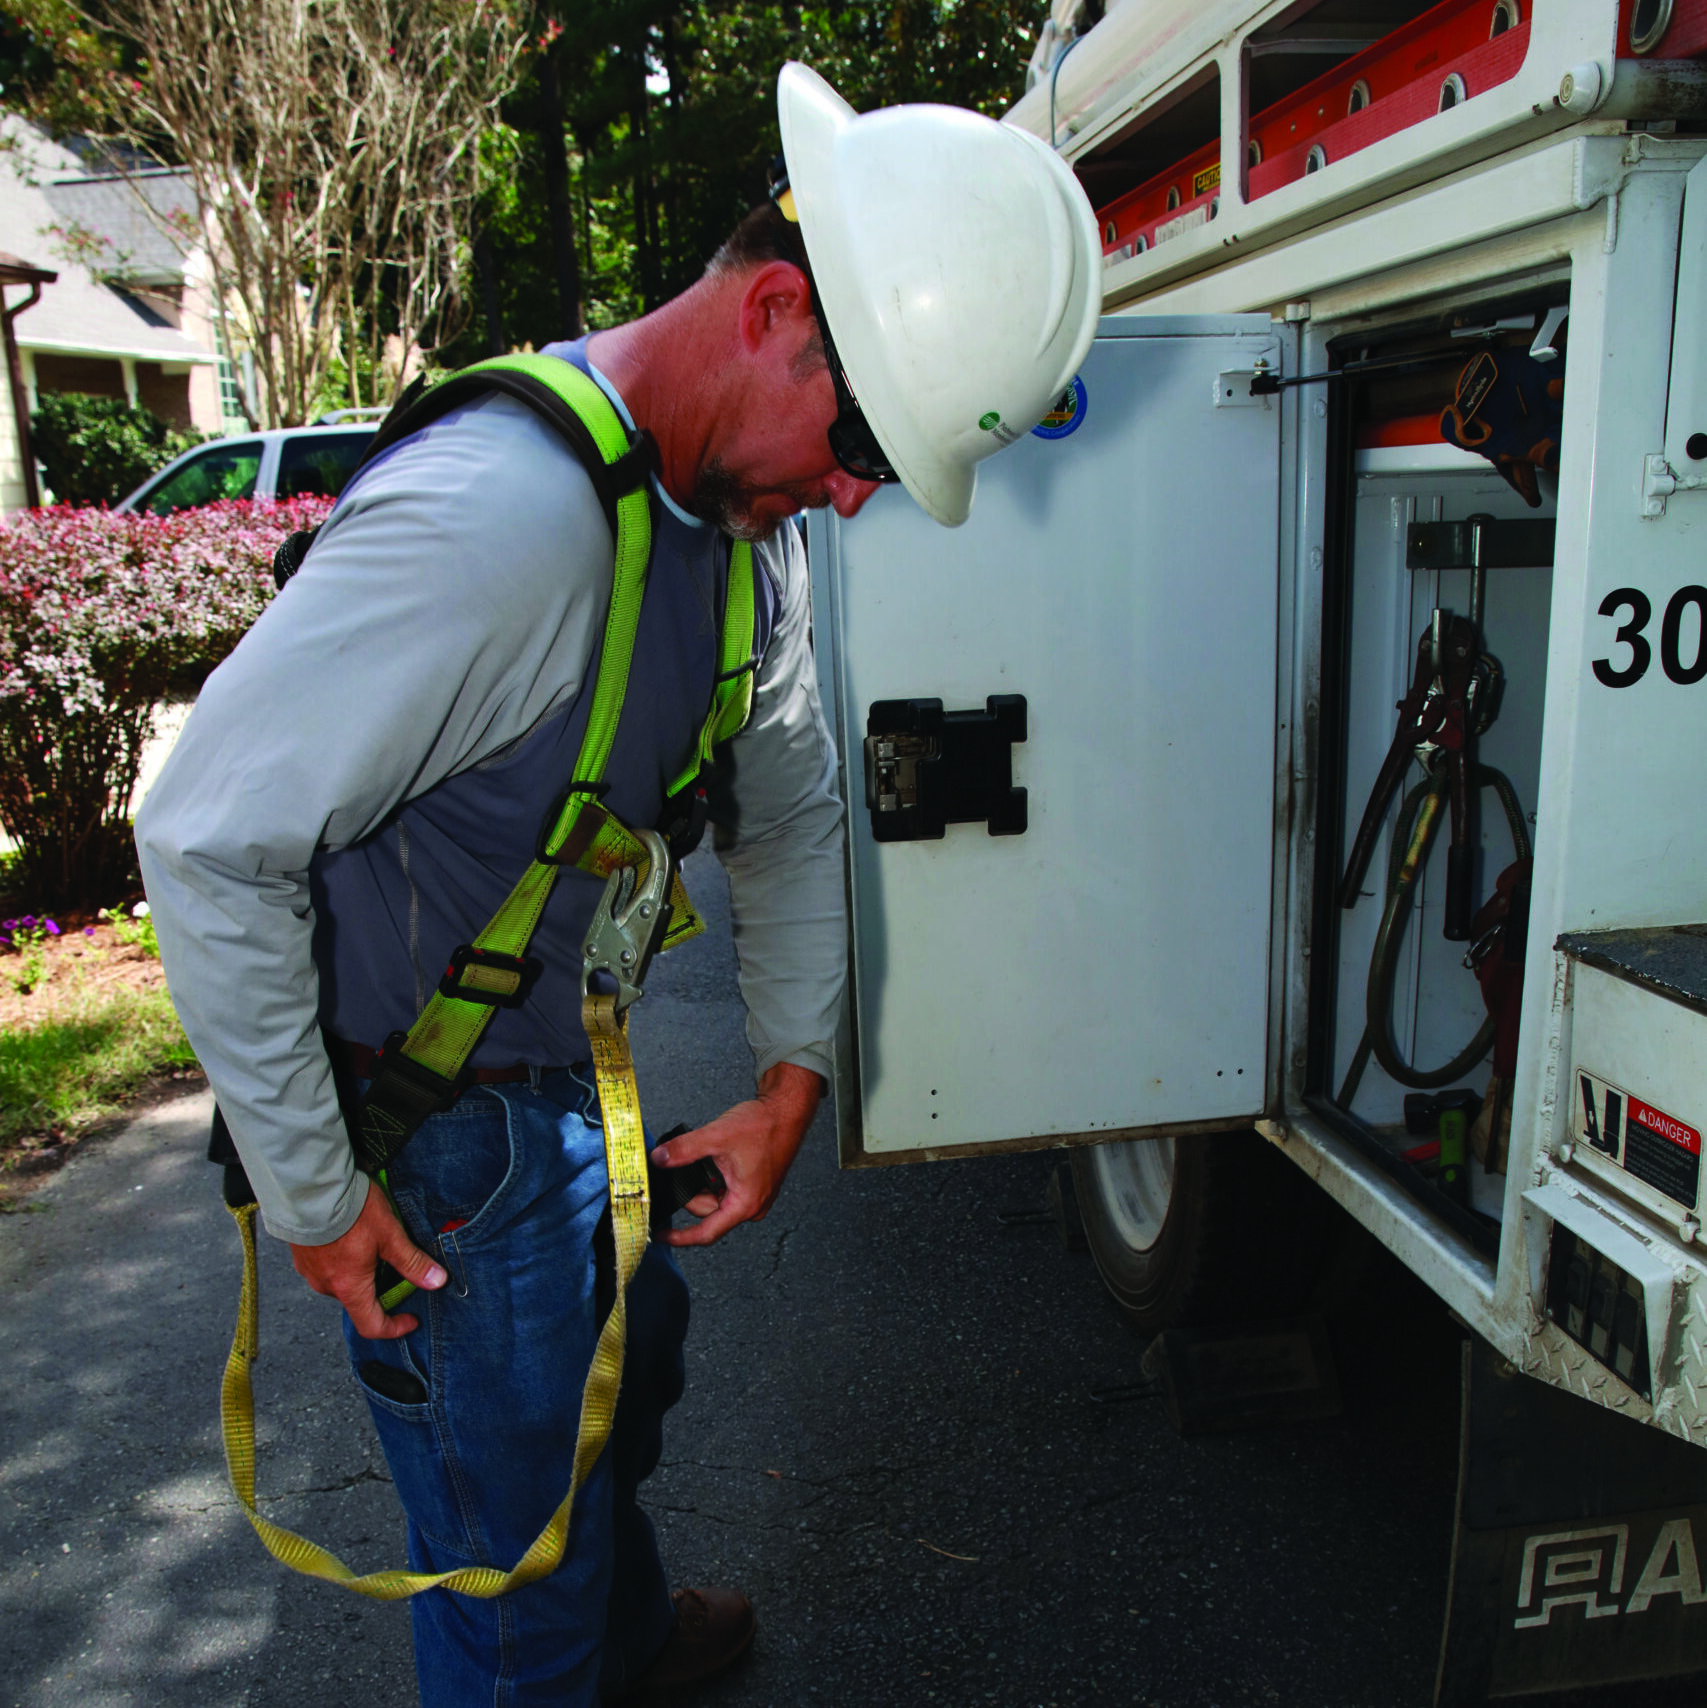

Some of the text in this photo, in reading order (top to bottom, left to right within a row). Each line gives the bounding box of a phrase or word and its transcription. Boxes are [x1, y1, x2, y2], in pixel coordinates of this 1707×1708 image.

[1197, 167, 1221, 189] CAUTIO
[1592, 585, 1707, 688] 30
[1648, 1112, 1691, 1147] DANGER
[1625, 1518, 1707, 1613] A
